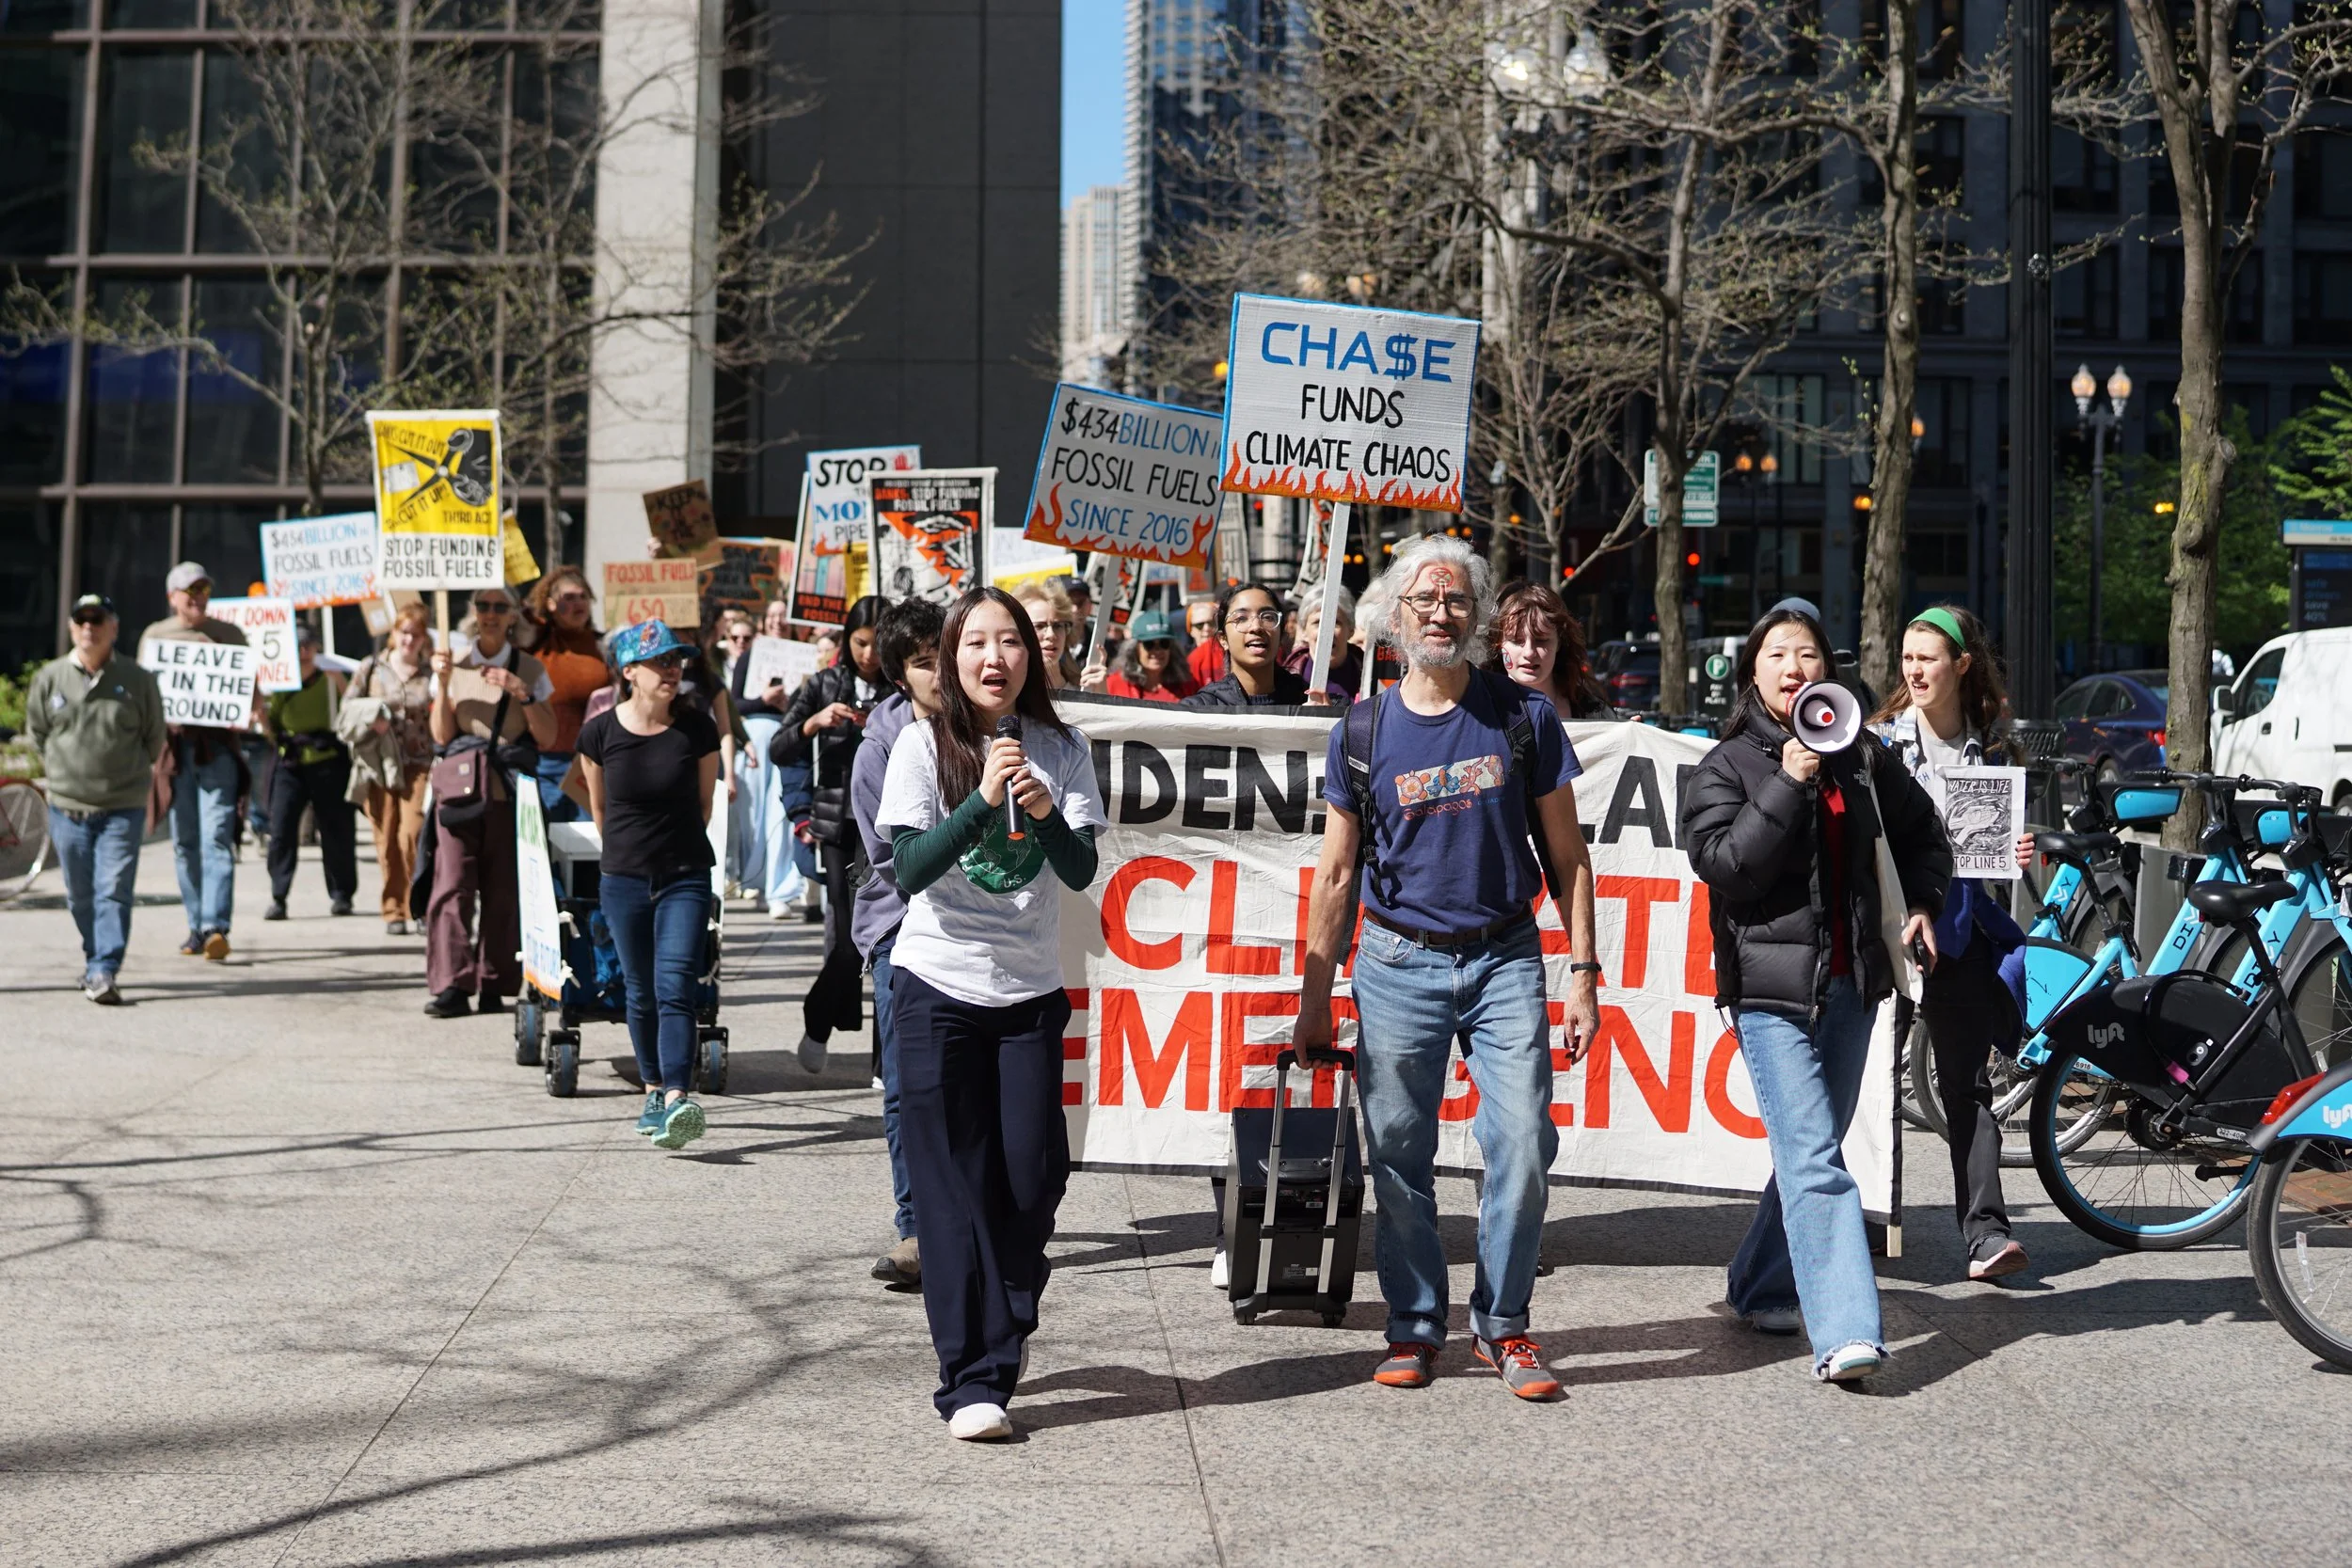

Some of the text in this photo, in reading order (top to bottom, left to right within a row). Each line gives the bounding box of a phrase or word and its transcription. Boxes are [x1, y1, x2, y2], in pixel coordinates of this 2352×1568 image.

[1261, 321, 1457, 383] CHA$E
[1301, 384, 1405, 429] FUNDS
[1246, 430, 1451, 483] CLIMATE CHAOS
[815, 456, 886, 487] STOP
[1051, 447, 1219, 507] FOSSIL FUELS
[834, 525, 868, 543] PIPE
[1065, 499, 1190, 546] SINCE 2016
[275, 546, 373, 574] FOSSIL FUELS
[386, 538, 423, 557] STOP
[429, 538, 498, 558] FUNDING
[383, 560, 494, 578] FOSSIL FUELS
[607, 562, 656, 583] FOSSIL
[245, 606, 287, 627] DOWN
[157, 643, 246, 670] LEAVE
[263, 630, 281, 660] 5
[172, 671, 195, 689] IN
[207, 673, 252, 696] THE
[163, 697, 242, 721] ROUND
[1947, 779, 2010, 794] WATER IS LIFE
[1955, 856, 2007, 869] TOP LINE 5
[2088, 1022, 2125, 1049] lyft
